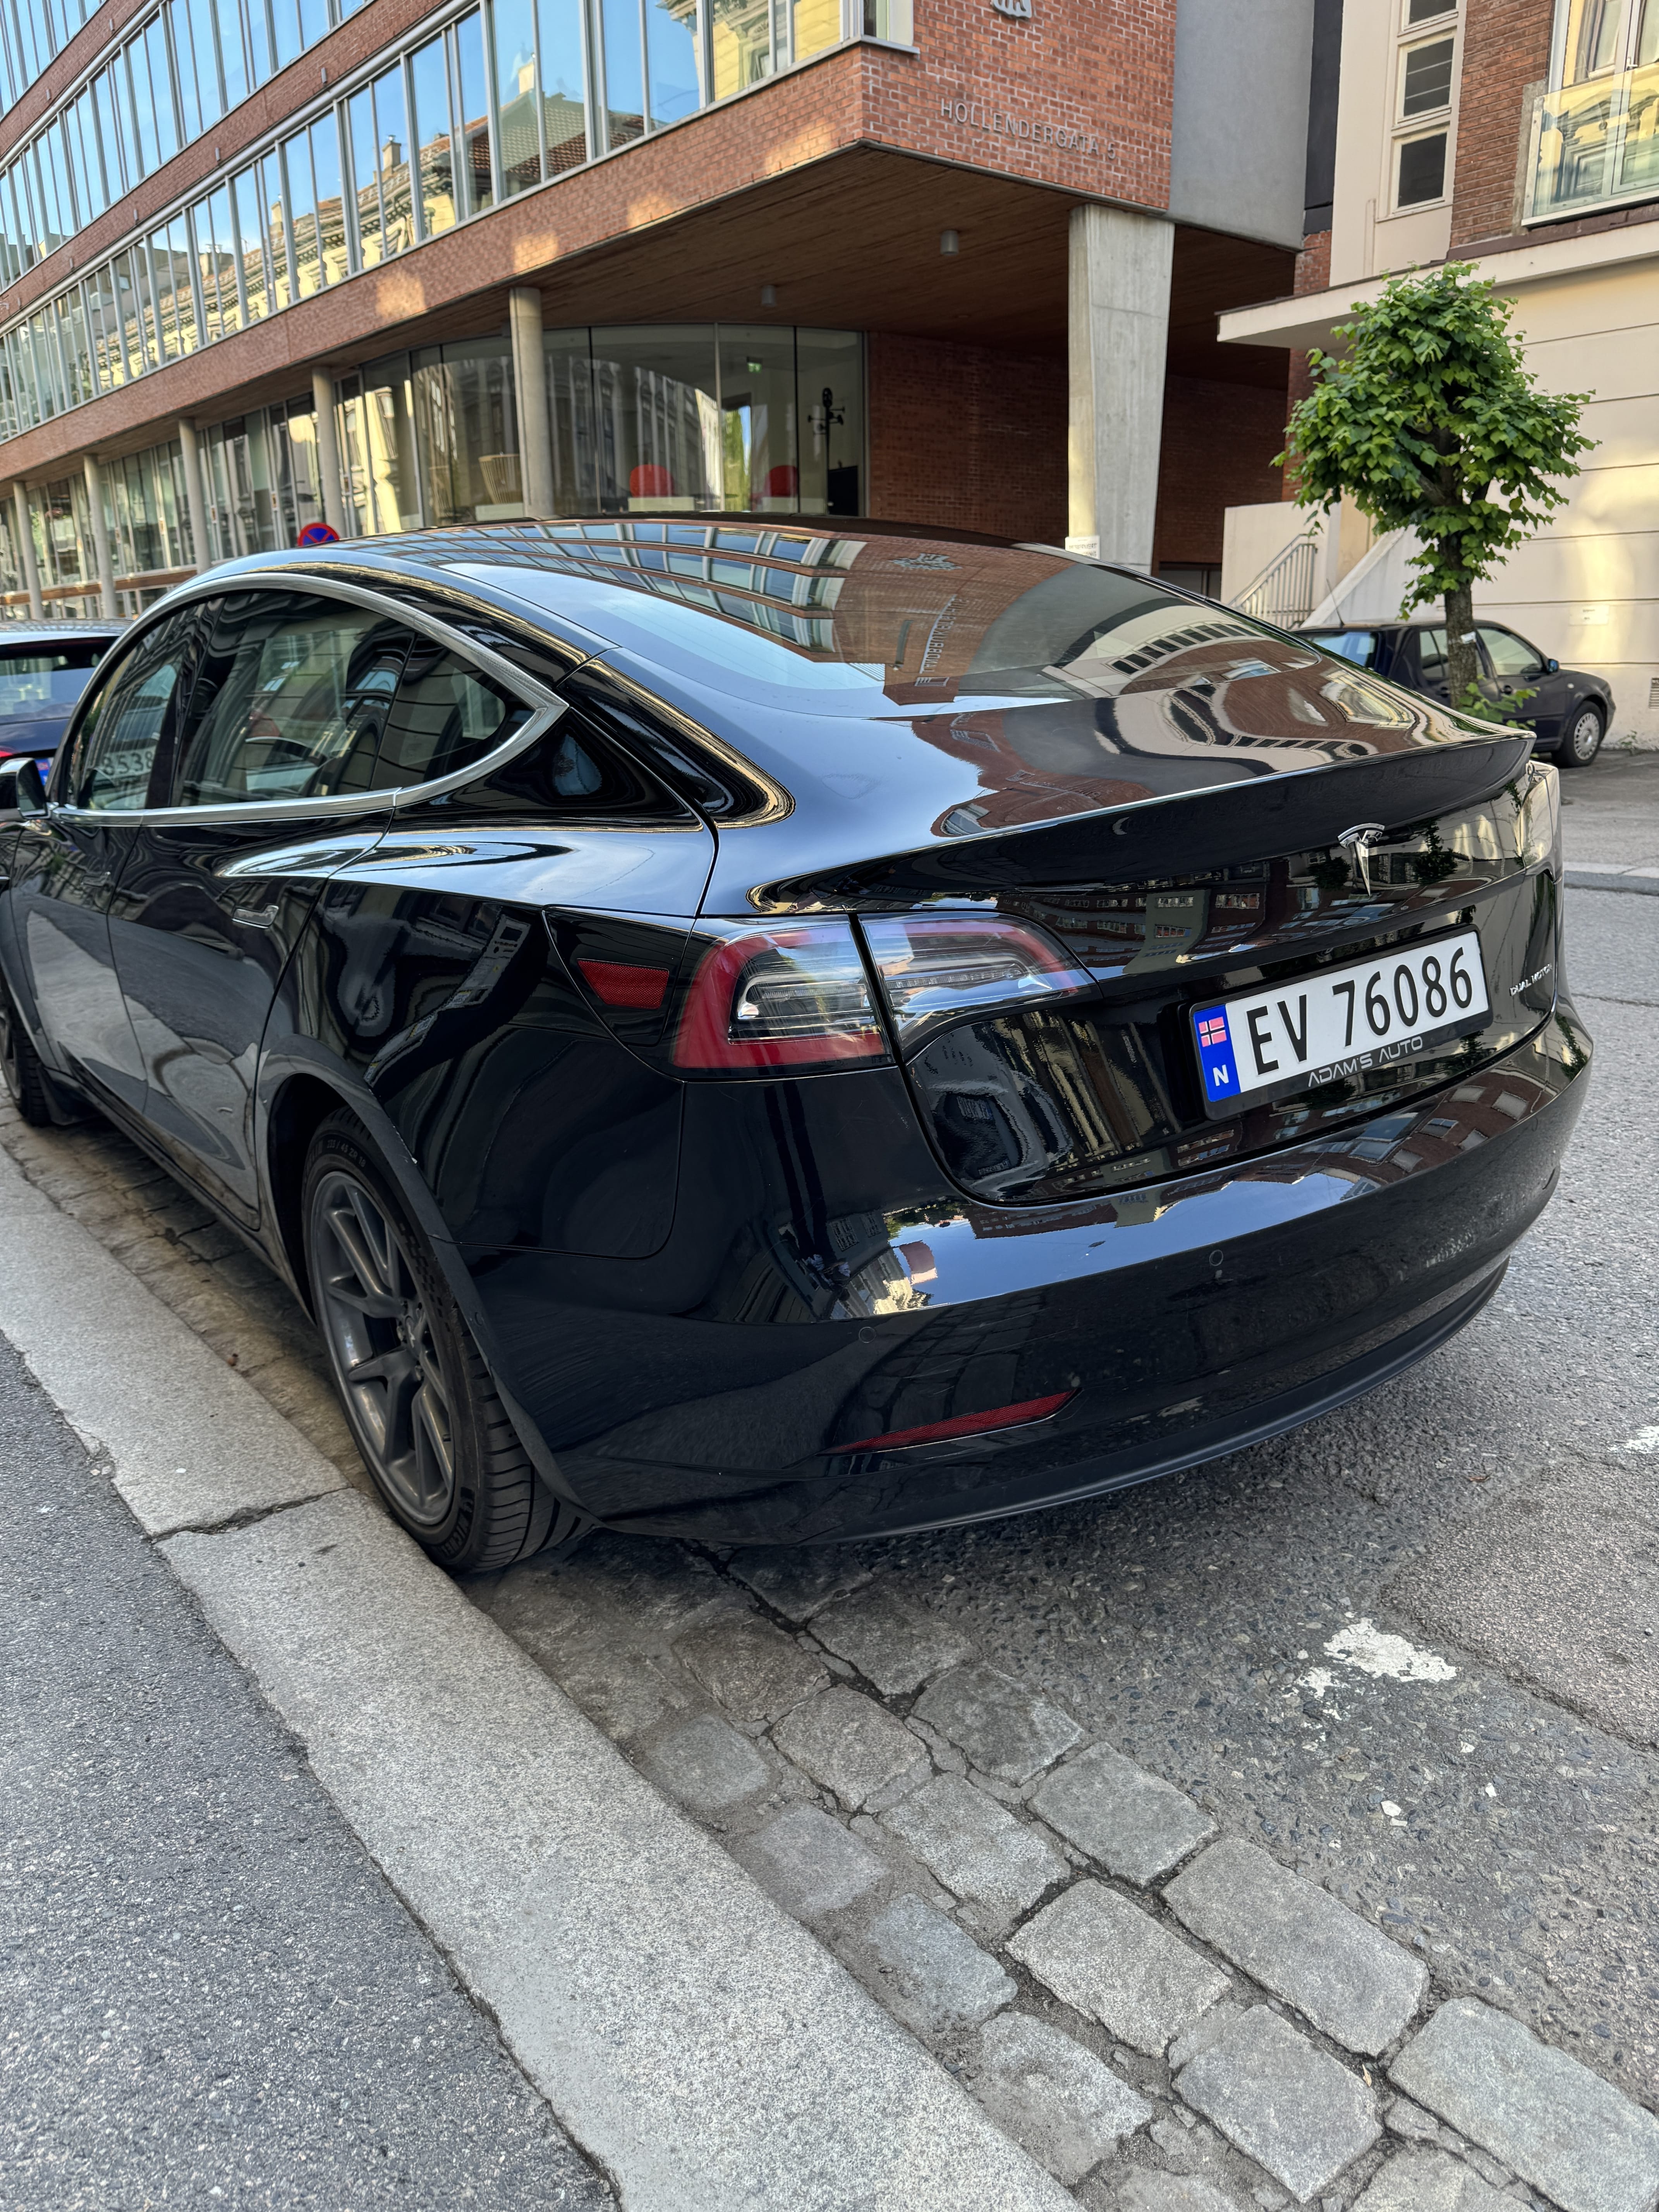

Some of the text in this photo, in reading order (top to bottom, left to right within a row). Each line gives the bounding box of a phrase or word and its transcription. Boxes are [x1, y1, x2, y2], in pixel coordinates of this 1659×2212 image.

[941, 98, 1116, 159] HOLLENDERGATA 5
[1246, 946, 1472, 1075] EV 76086
[1510, 979, 1532, 996] DUAL
[1212, 1065, 1229, 1086] N
[1308, 1036, 1423, 1087] ADAM'S AUTO
